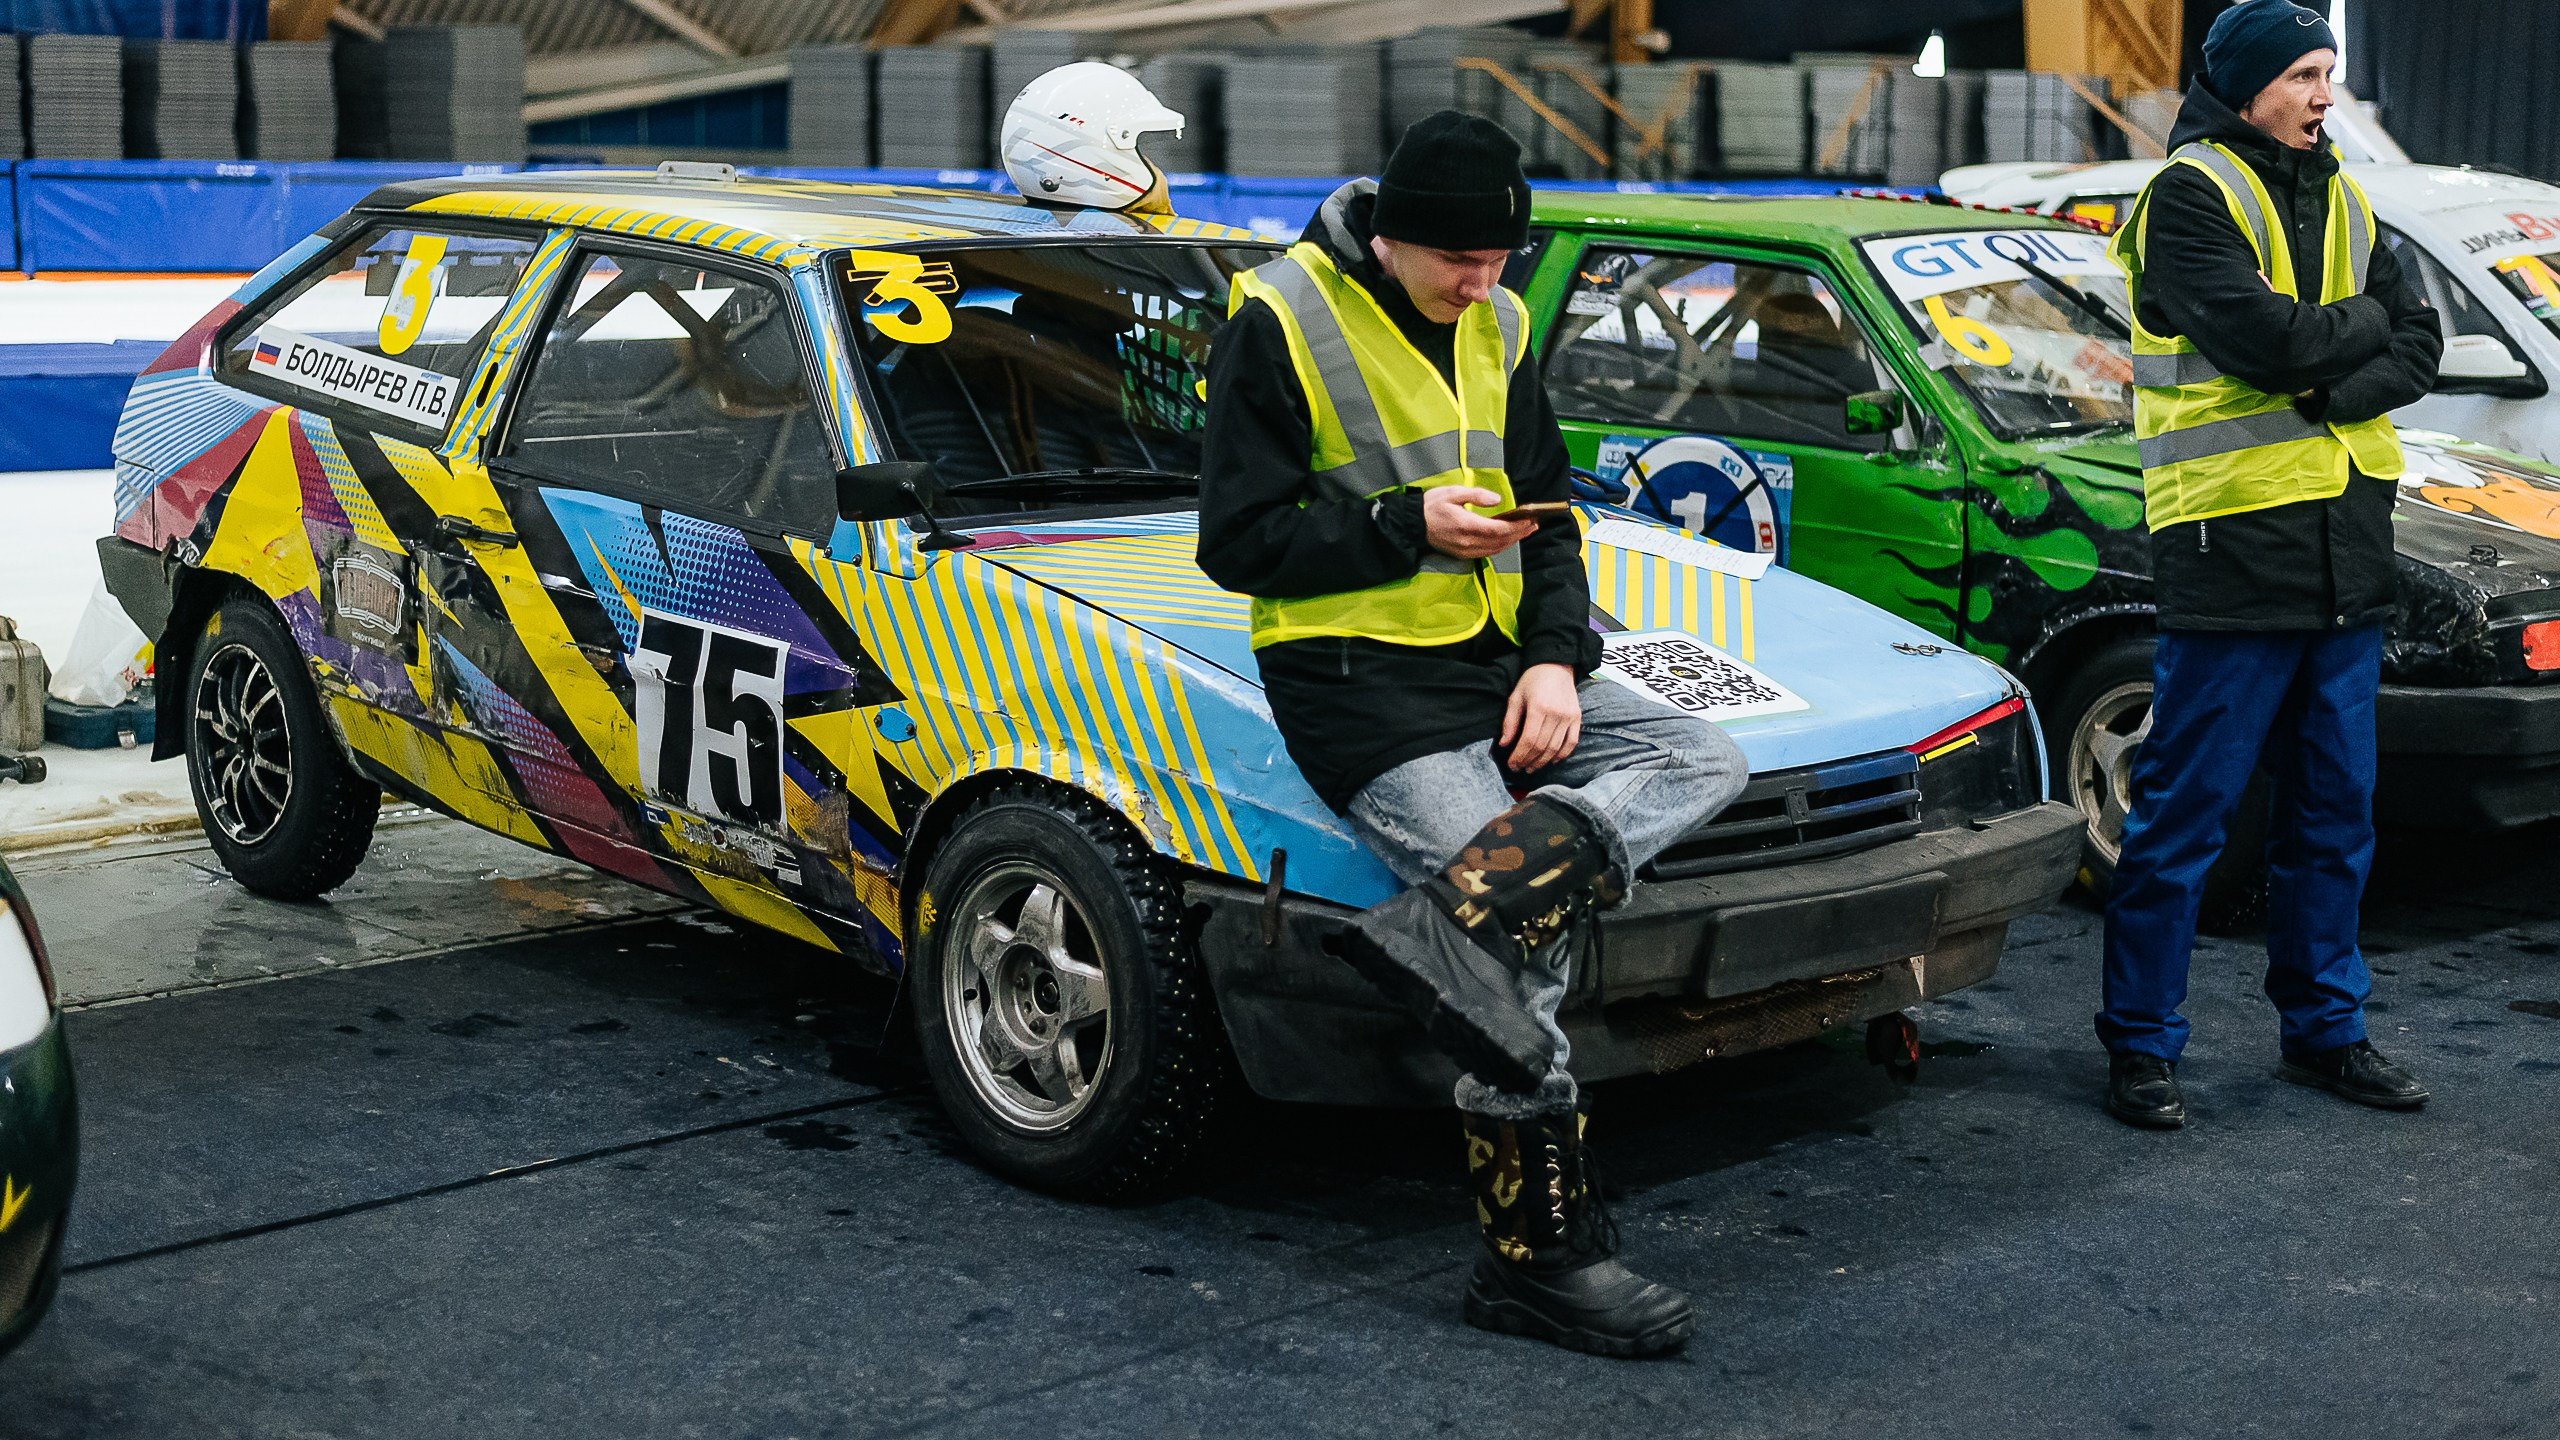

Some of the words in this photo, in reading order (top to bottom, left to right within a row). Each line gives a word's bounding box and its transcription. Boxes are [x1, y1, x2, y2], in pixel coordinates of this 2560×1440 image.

[1892, 239, 1982, 276] GT
[1984, 232, 2087, 263] OIL
[379, 235, 448, 355] 3
[850, 249, 952, 344] 3
[1923, 294, 2012, 366] 6
[286, 343, 408, 403] БОЛДЫРЕВ
[407, 380, 447, 418] П.В.
[1671, 491, 1707, 535] 1
[640, 614, 783, 826] 75
